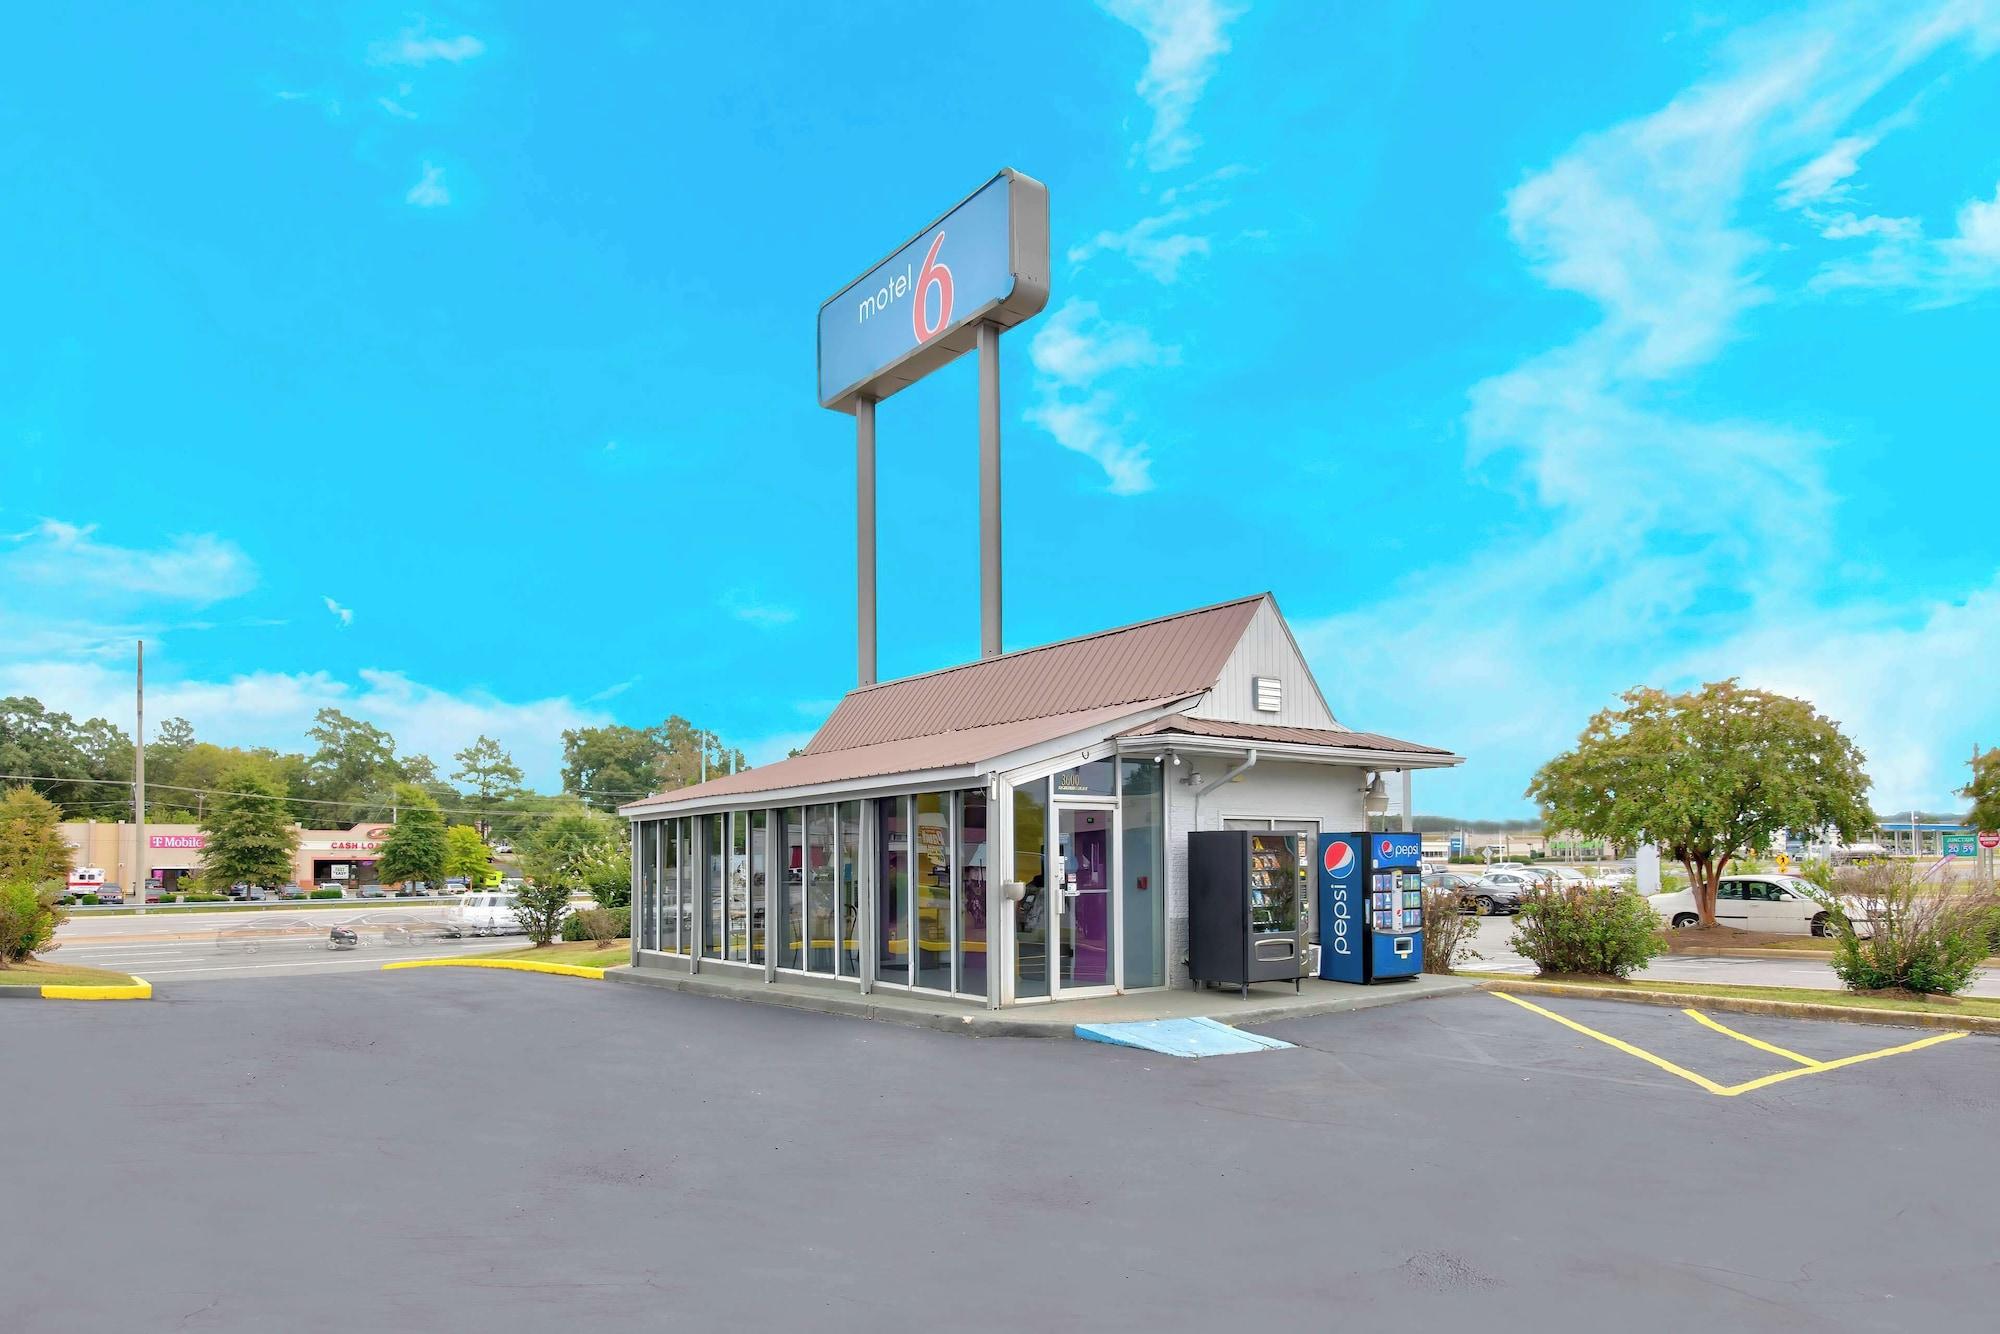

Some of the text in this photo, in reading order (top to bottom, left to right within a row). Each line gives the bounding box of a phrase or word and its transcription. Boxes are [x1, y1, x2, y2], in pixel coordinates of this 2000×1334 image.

[858, 230, 955, 345] motel 6
[164, 836, 202, 848] Mobile
[1962, 845, 1974, 853] 59
[1395, 844, 1419, 858] pepsi
[1330, 884, 1351, 954] pepsi
